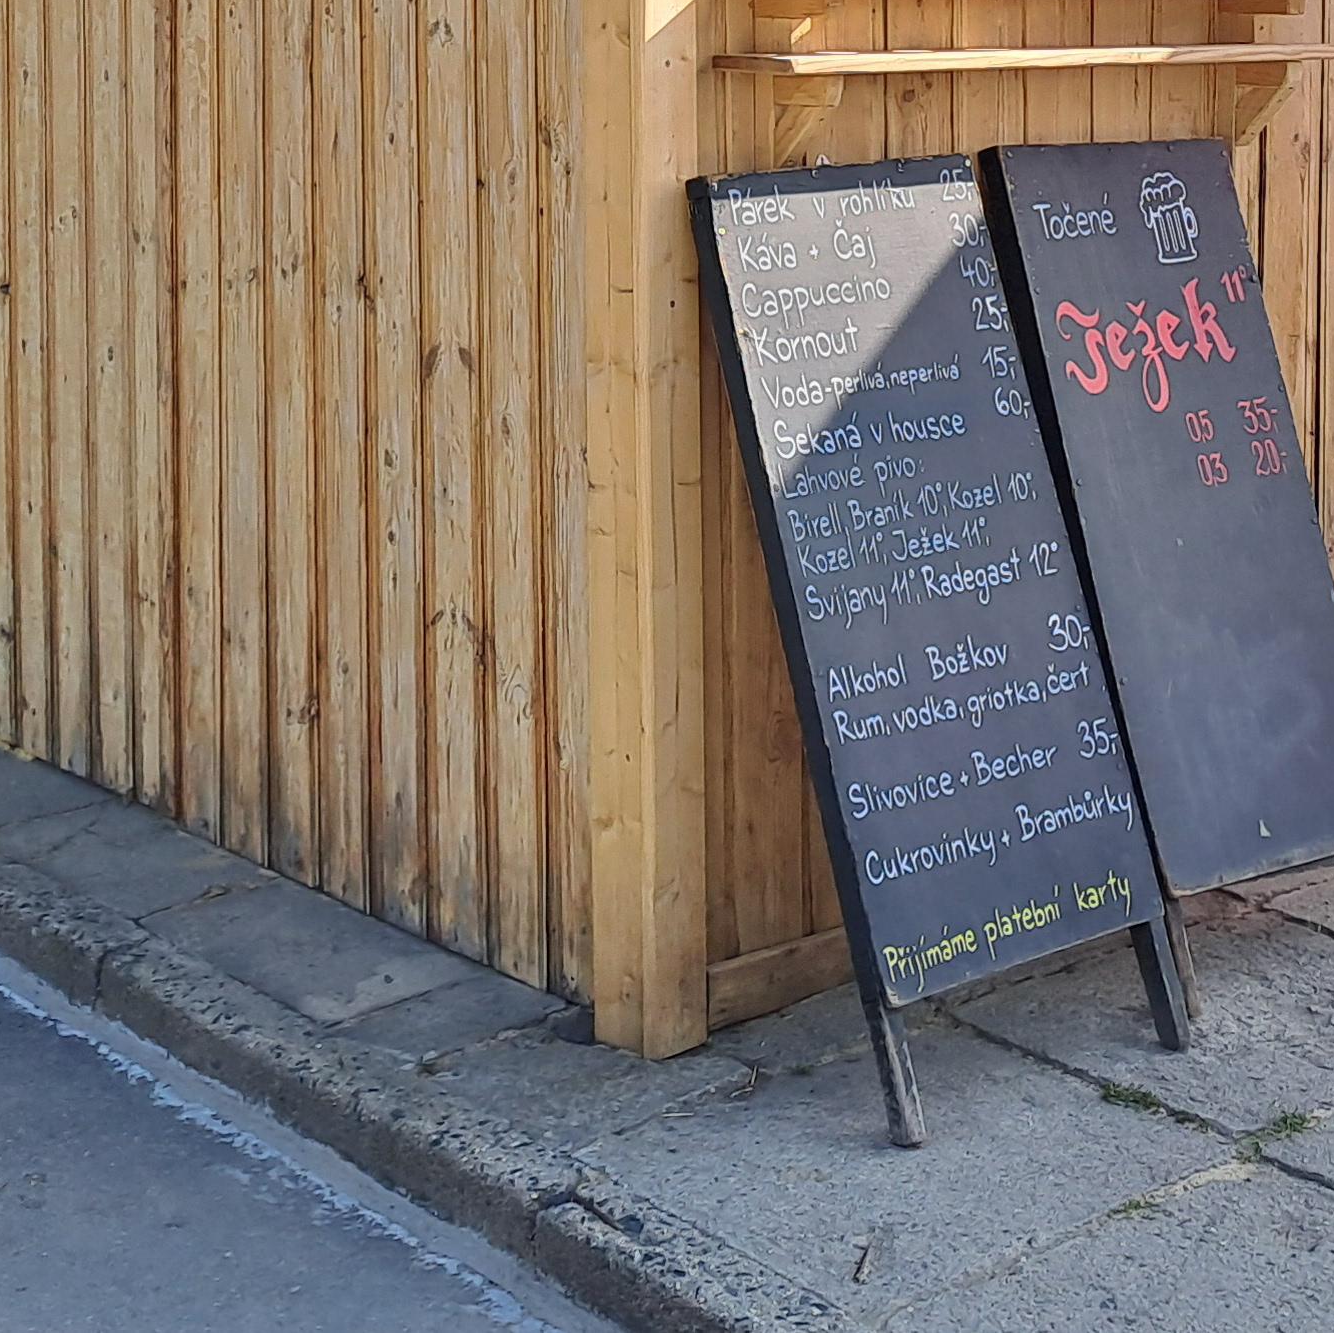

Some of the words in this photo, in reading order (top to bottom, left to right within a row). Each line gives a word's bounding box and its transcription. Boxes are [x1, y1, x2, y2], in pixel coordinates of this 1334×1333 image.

[728, 185, 795, 226] Párek
[812, 197, 825, 218] v
[840, 178, 915, 211] rohlíku
[1032, 192, 1117, 241] Točené
[737, 232, 797, 272] Káva
[833, 220, 876, 268] Čaj
[741, 275, 891, 330] Cappuccino
[752, 317, 859, 366] Kornout
[1055, 276, 1238, 414] Ježek
[1220, 265, 1248, 304] 11°
[773, 411, 863, 460] Sekaná
[870, 422, 883, 444] v
[888, 411, 967, 443] housce
[777, 452, 866, 499] Lahvové
[874, 454, 925, 497] pivo:
[847, 489, 914, 531] Braník
[948, 473, 1003, 514] Kozel
[796, 528, 857, 579] Kozel
[891, 525, 960, 562] Ježek
[804, 584, 888, 630] Svijany
[921, 546, 1021, 606] Radegast
[1028, 541, 1059, 578] 12°
[828, 653, 908, 703] Alkohol
[925, 635, 1009, 681] Božkov
[1046, 660, 1090, 696] čert
[847, 771, 955, 819] Slivovice
[970, 744, 1059, 787] Becher
[865, 827, 997, 885] Cukrovinky
[1014, 785, 1134, 842] Brambůrky
[983, 884, 1061, 961] platební
[1073, 869, 1131, 917] karty
